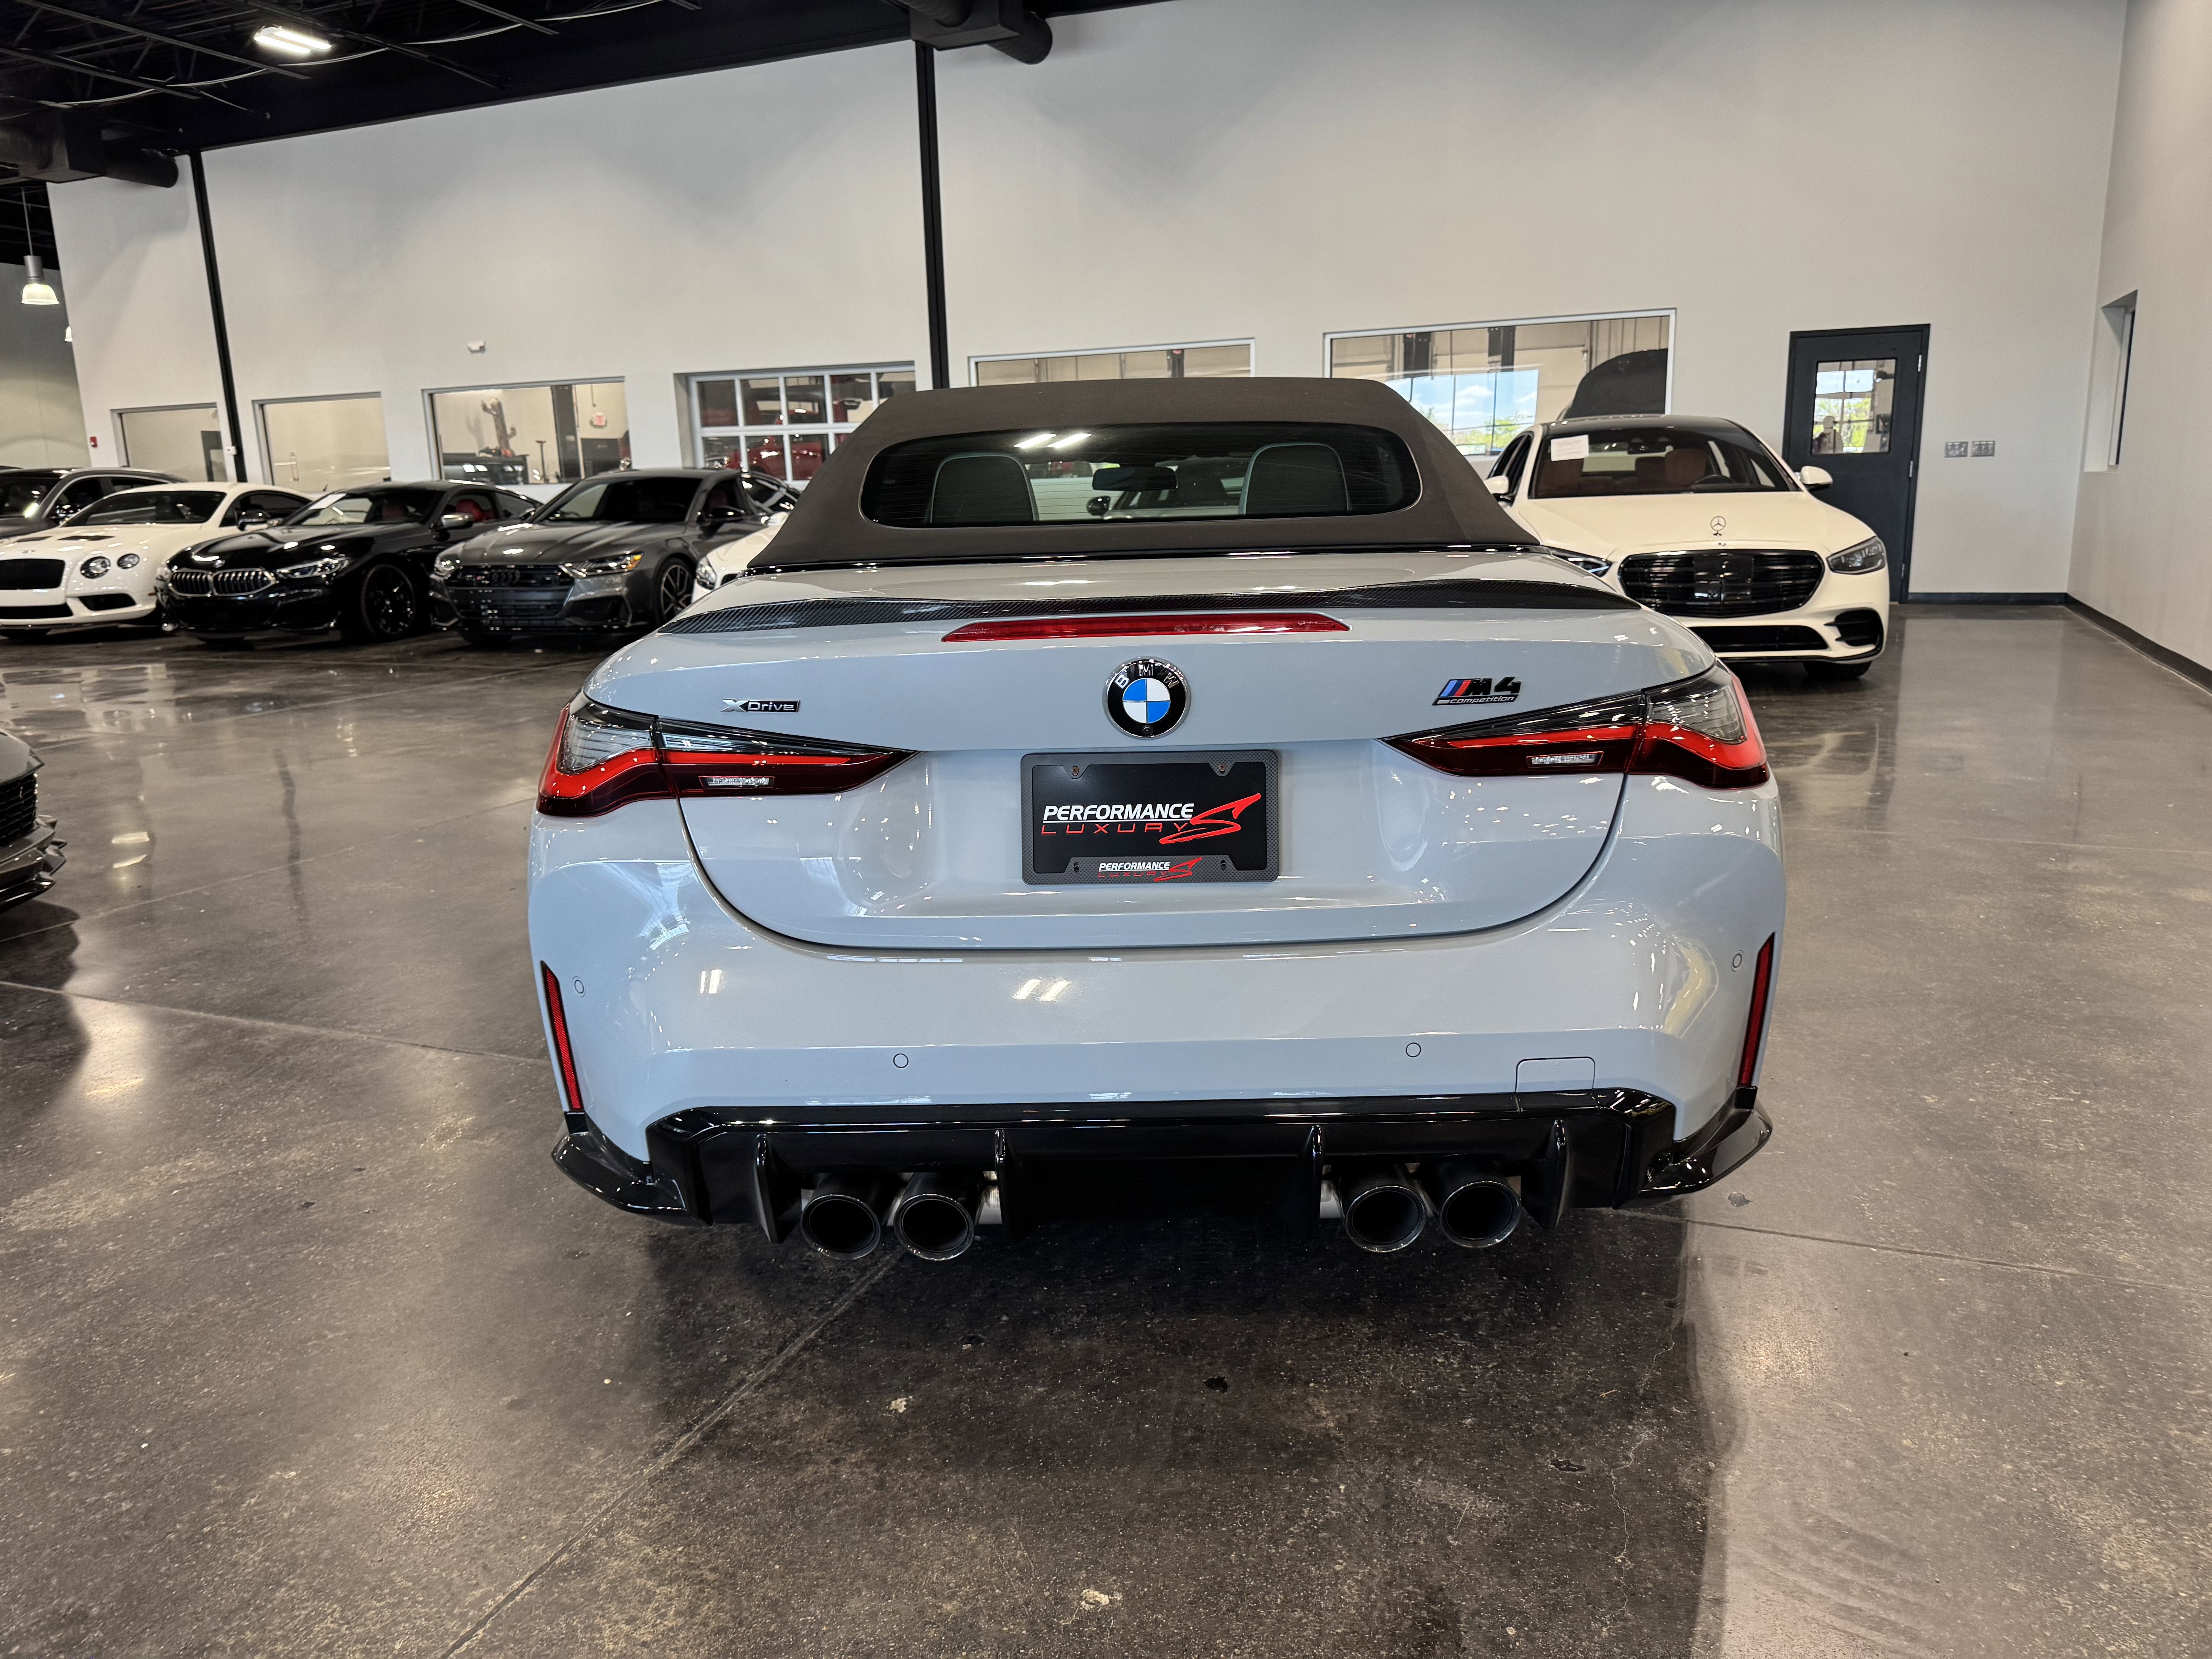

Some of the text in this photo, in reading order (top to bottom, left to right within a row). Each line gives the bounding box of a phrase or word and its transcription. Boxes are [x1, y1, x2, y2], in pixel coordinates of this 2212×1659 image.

[1115, 664, 1180, 689] BMW
[1462, 677, 1521, 696] M4
[1449, 696, 1515, 704] competition
[1042, 803, 1195, 821] PERFORMANCE
[1041, 823, 1188, 835] LUXURY
[1099, 861, 1171, 871] PERFORMANCE
